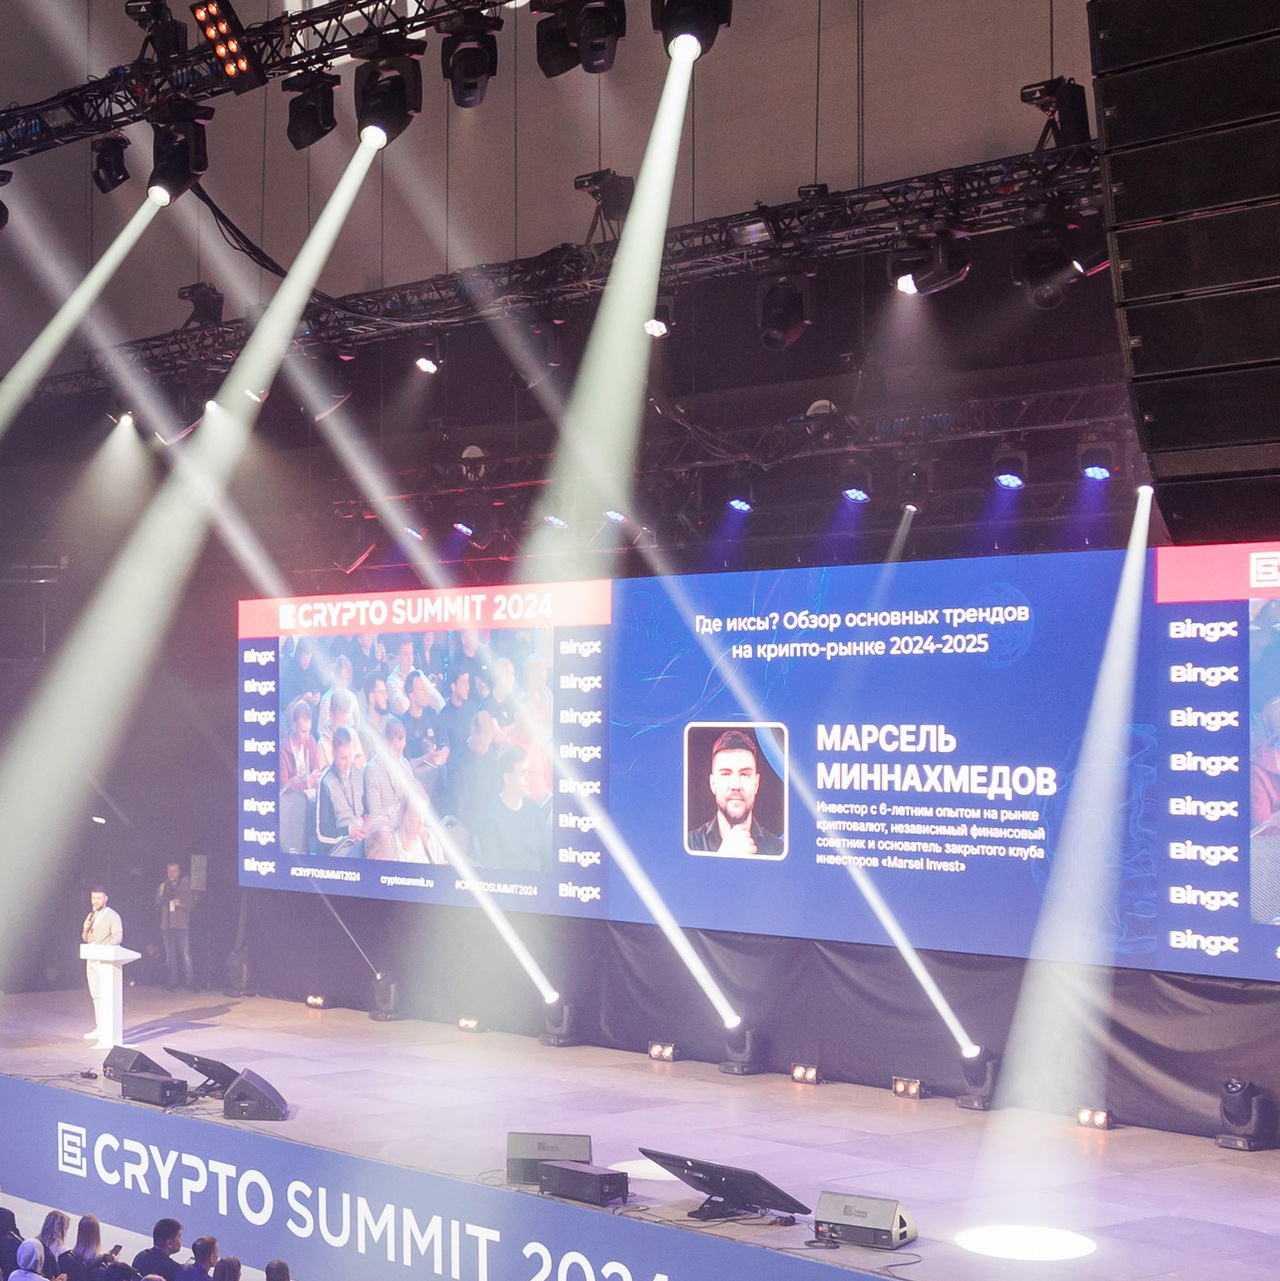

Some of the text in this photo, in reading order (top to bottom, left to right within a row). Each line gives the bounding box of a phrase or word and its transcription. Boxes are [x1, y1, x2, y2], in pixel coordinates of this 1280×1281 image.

[297, 593, 552, 628] CRYPTO SUMMIT 2024
[695, 605, 1030, 635] Где иксы? Обзор основных трендов
[732, 633, 989, 661] на крипто-рынке 2024-2025
[816, 724, 957, 753] МАРСЕЛЬ
[816, 762, 1057, 801] МИННАХМЕДОВ
[816, 801, 1039, 822] Инвестор с 6-летним опытом на рынке
[816, 820, 1045, 840] криптовалют, независимый финансовый
[816, 837, 1045, 860] советник и основатель закрытого клуба
[816, 854, 879, 868] инвесторов
[926, 858, 966, 872] Invest»
[92, 1132, 275, 1227] CRYPTO
